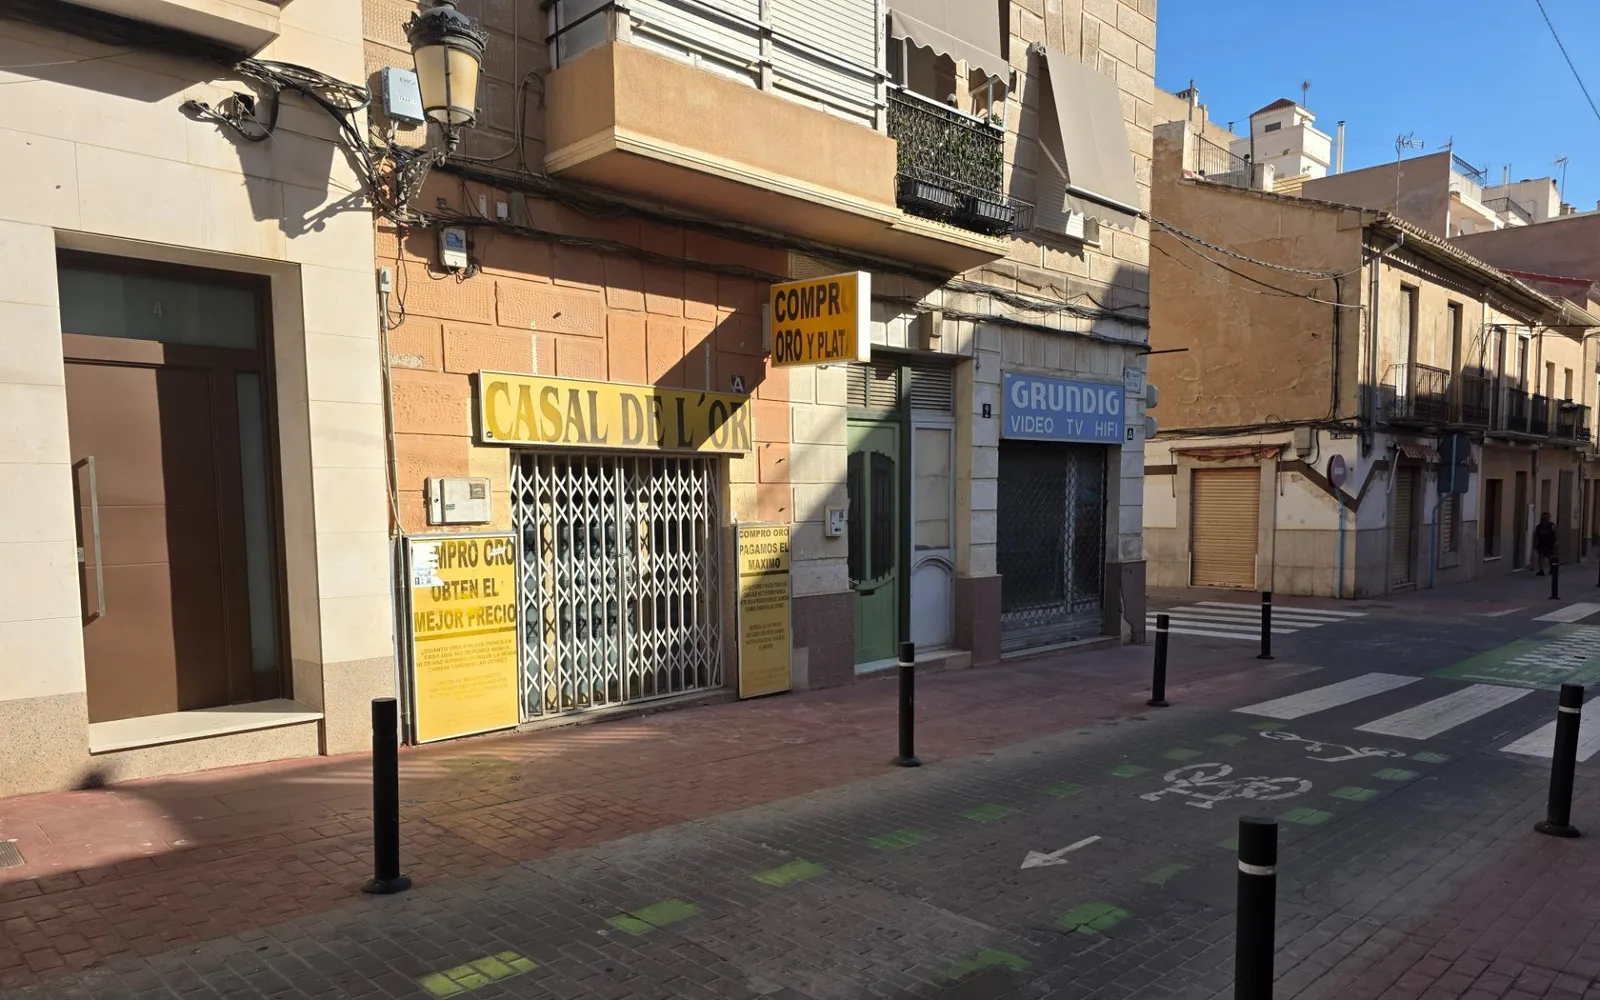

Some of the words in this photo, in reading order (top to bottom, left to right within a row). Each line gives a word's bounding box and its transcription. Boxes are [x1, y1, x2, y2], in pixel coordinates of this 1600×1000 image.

[153, 301, 162, 318] 4
[776, 328, 802, 363] ORO
[807, 332, 814, 360] Y
[733, 376, 744, 393] A
[1011, 380, 1120, 416] GRUNDIG
[485, 381, 608, 444] CASAL
[620, 392, 665, 447] DE
[1011, 414, 1054, 434] VIDEO
[1067, 418, 1084, 436] TV
[1095, 421, 1118, 438] HIFI
[740, 530, 771, 539] COMPRO
[773, 528, 789, 537] ORO
[437, 541, 478, 570] MPRO
[740, 543, 778, 555] PAGAMOS
[780, 542, 789, 553] EL
[749, 557, 781, 571] MAXIMO
[431, 579, 479, 602] OBTEN
[483, 577, 499, 598] EL
[415, 608, 464, 632] MEJOR
[467, 603, 515, 628] PRECIO
